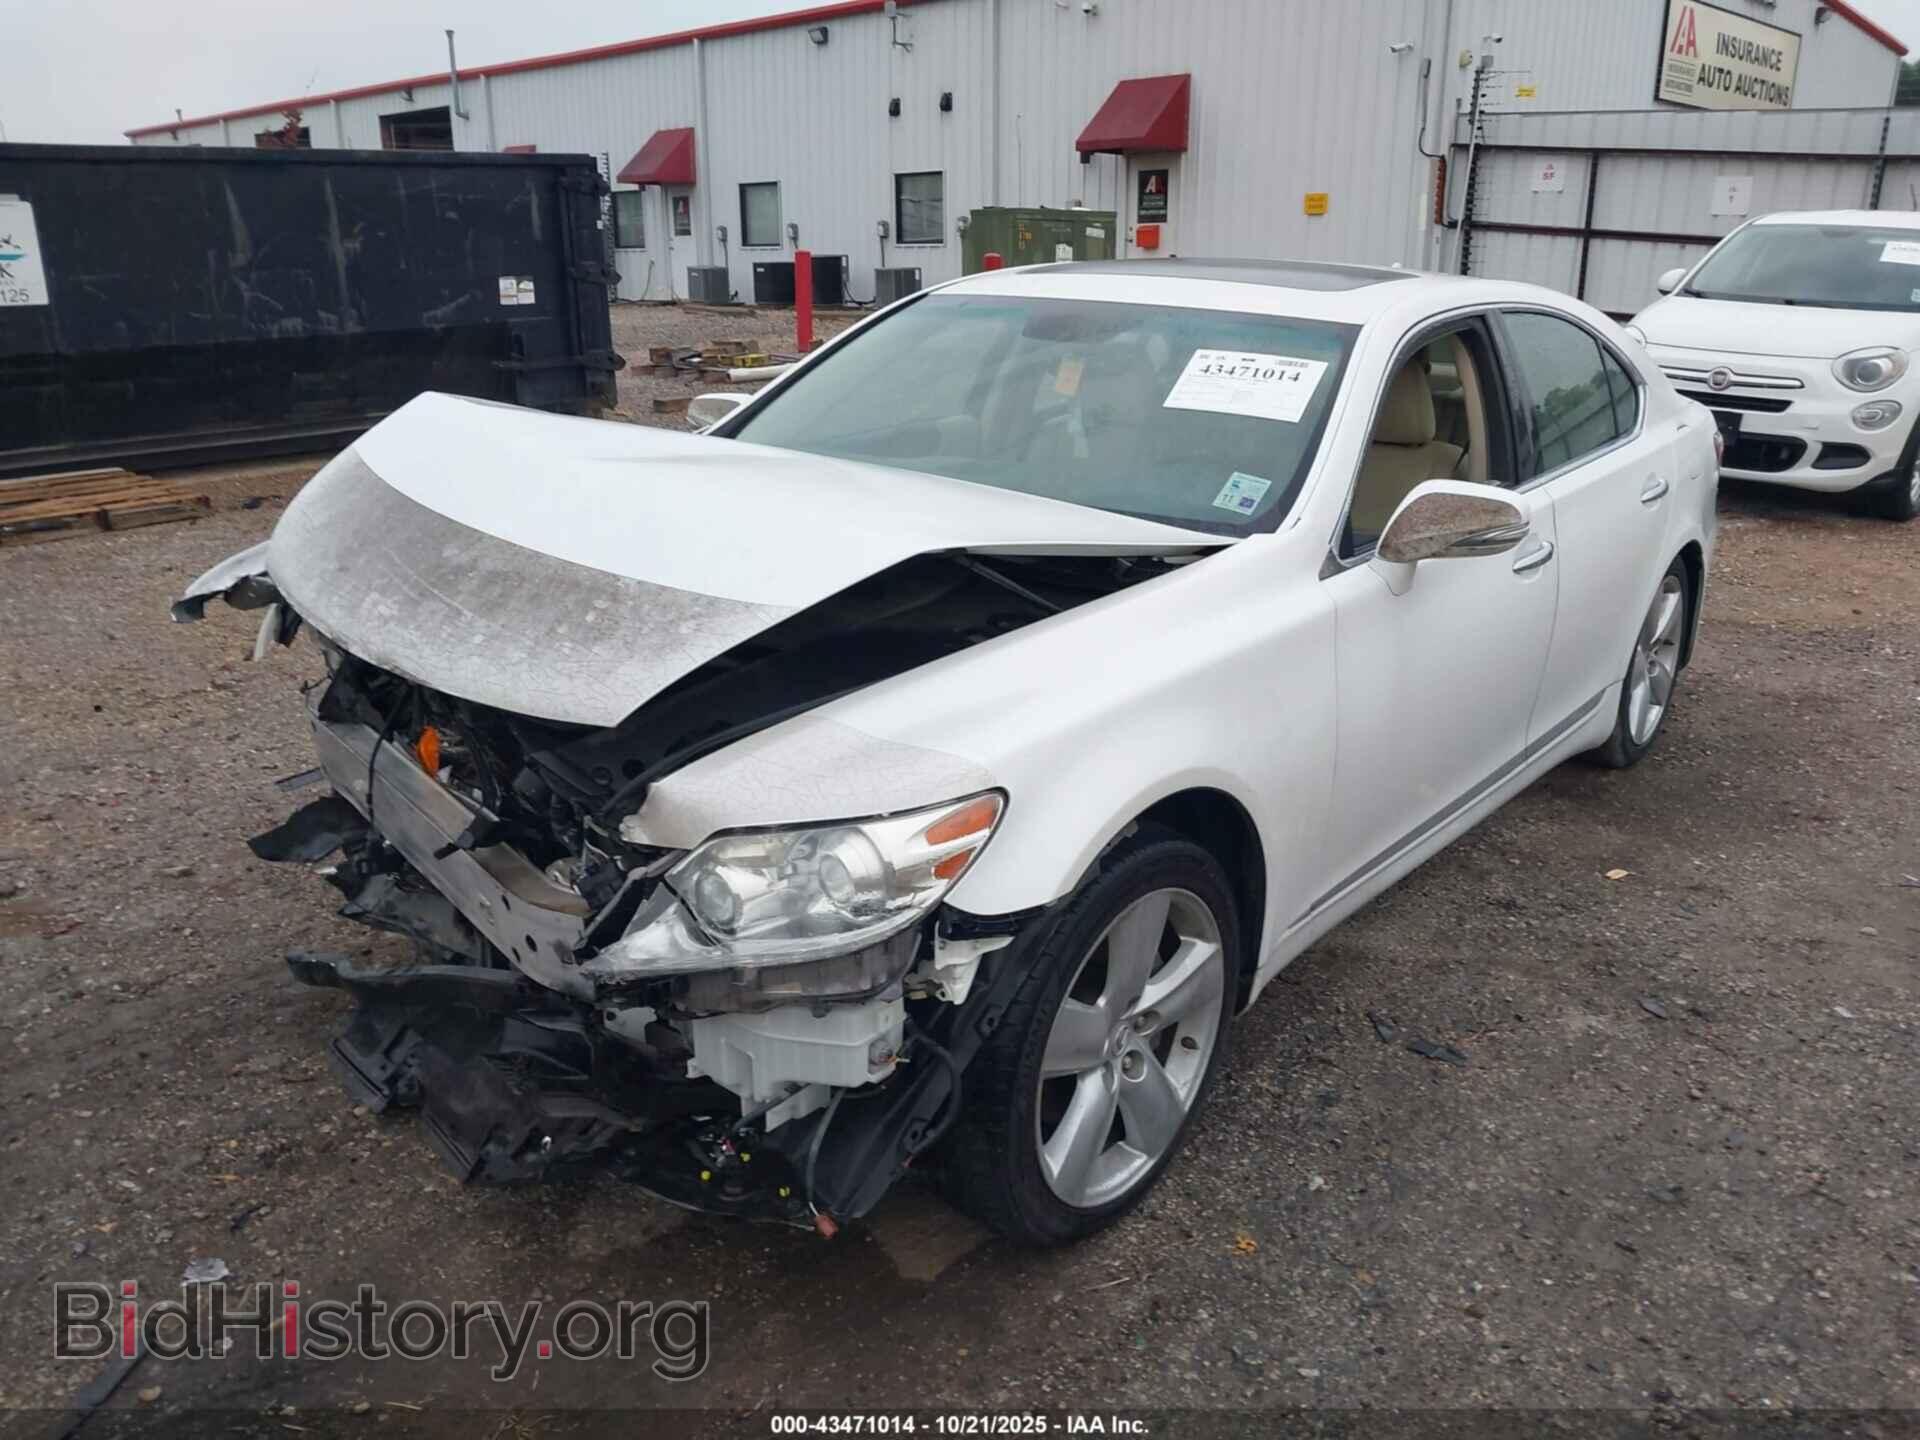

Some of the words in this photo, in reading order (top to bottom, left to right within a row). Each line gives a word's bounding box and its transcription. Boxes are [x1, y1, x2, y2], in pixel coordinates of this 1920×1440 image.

[1716, 32, 1783, 72] INSURANCE
[1697, 63, 1732, 92] AUTO
[1200, 364, 1301, 382] 43471014
